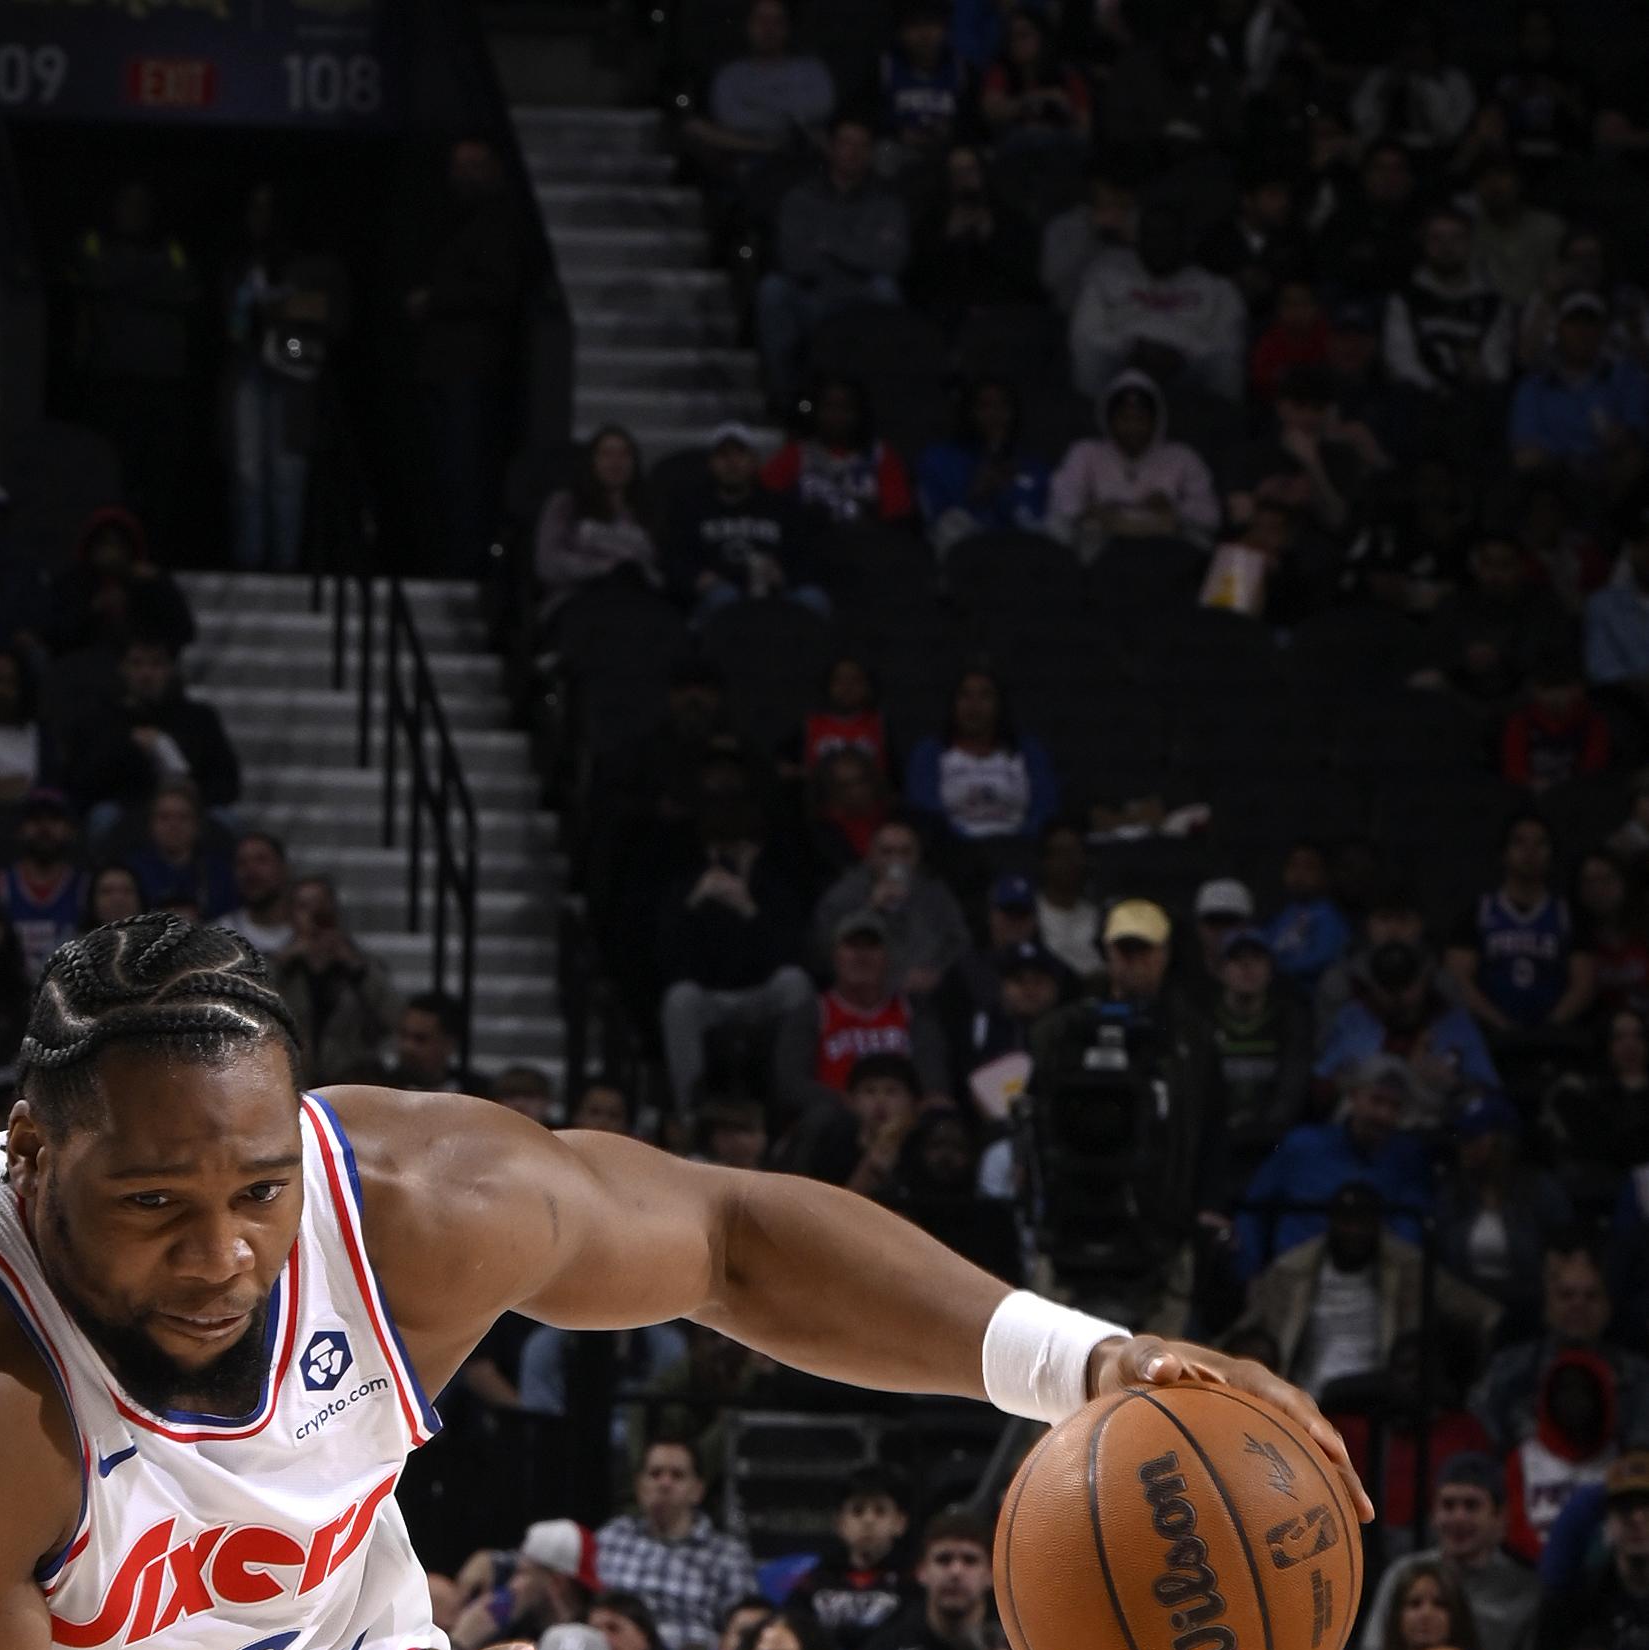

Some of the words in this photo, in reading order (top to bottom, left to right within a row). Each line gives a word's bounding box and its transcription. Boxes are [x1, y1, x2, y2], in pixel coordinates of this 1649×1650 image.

[139, 60, 207, 105] EXIT
[284, 53, 383, 114] 108
[295, 1377, 389, 1440] crypto.com
